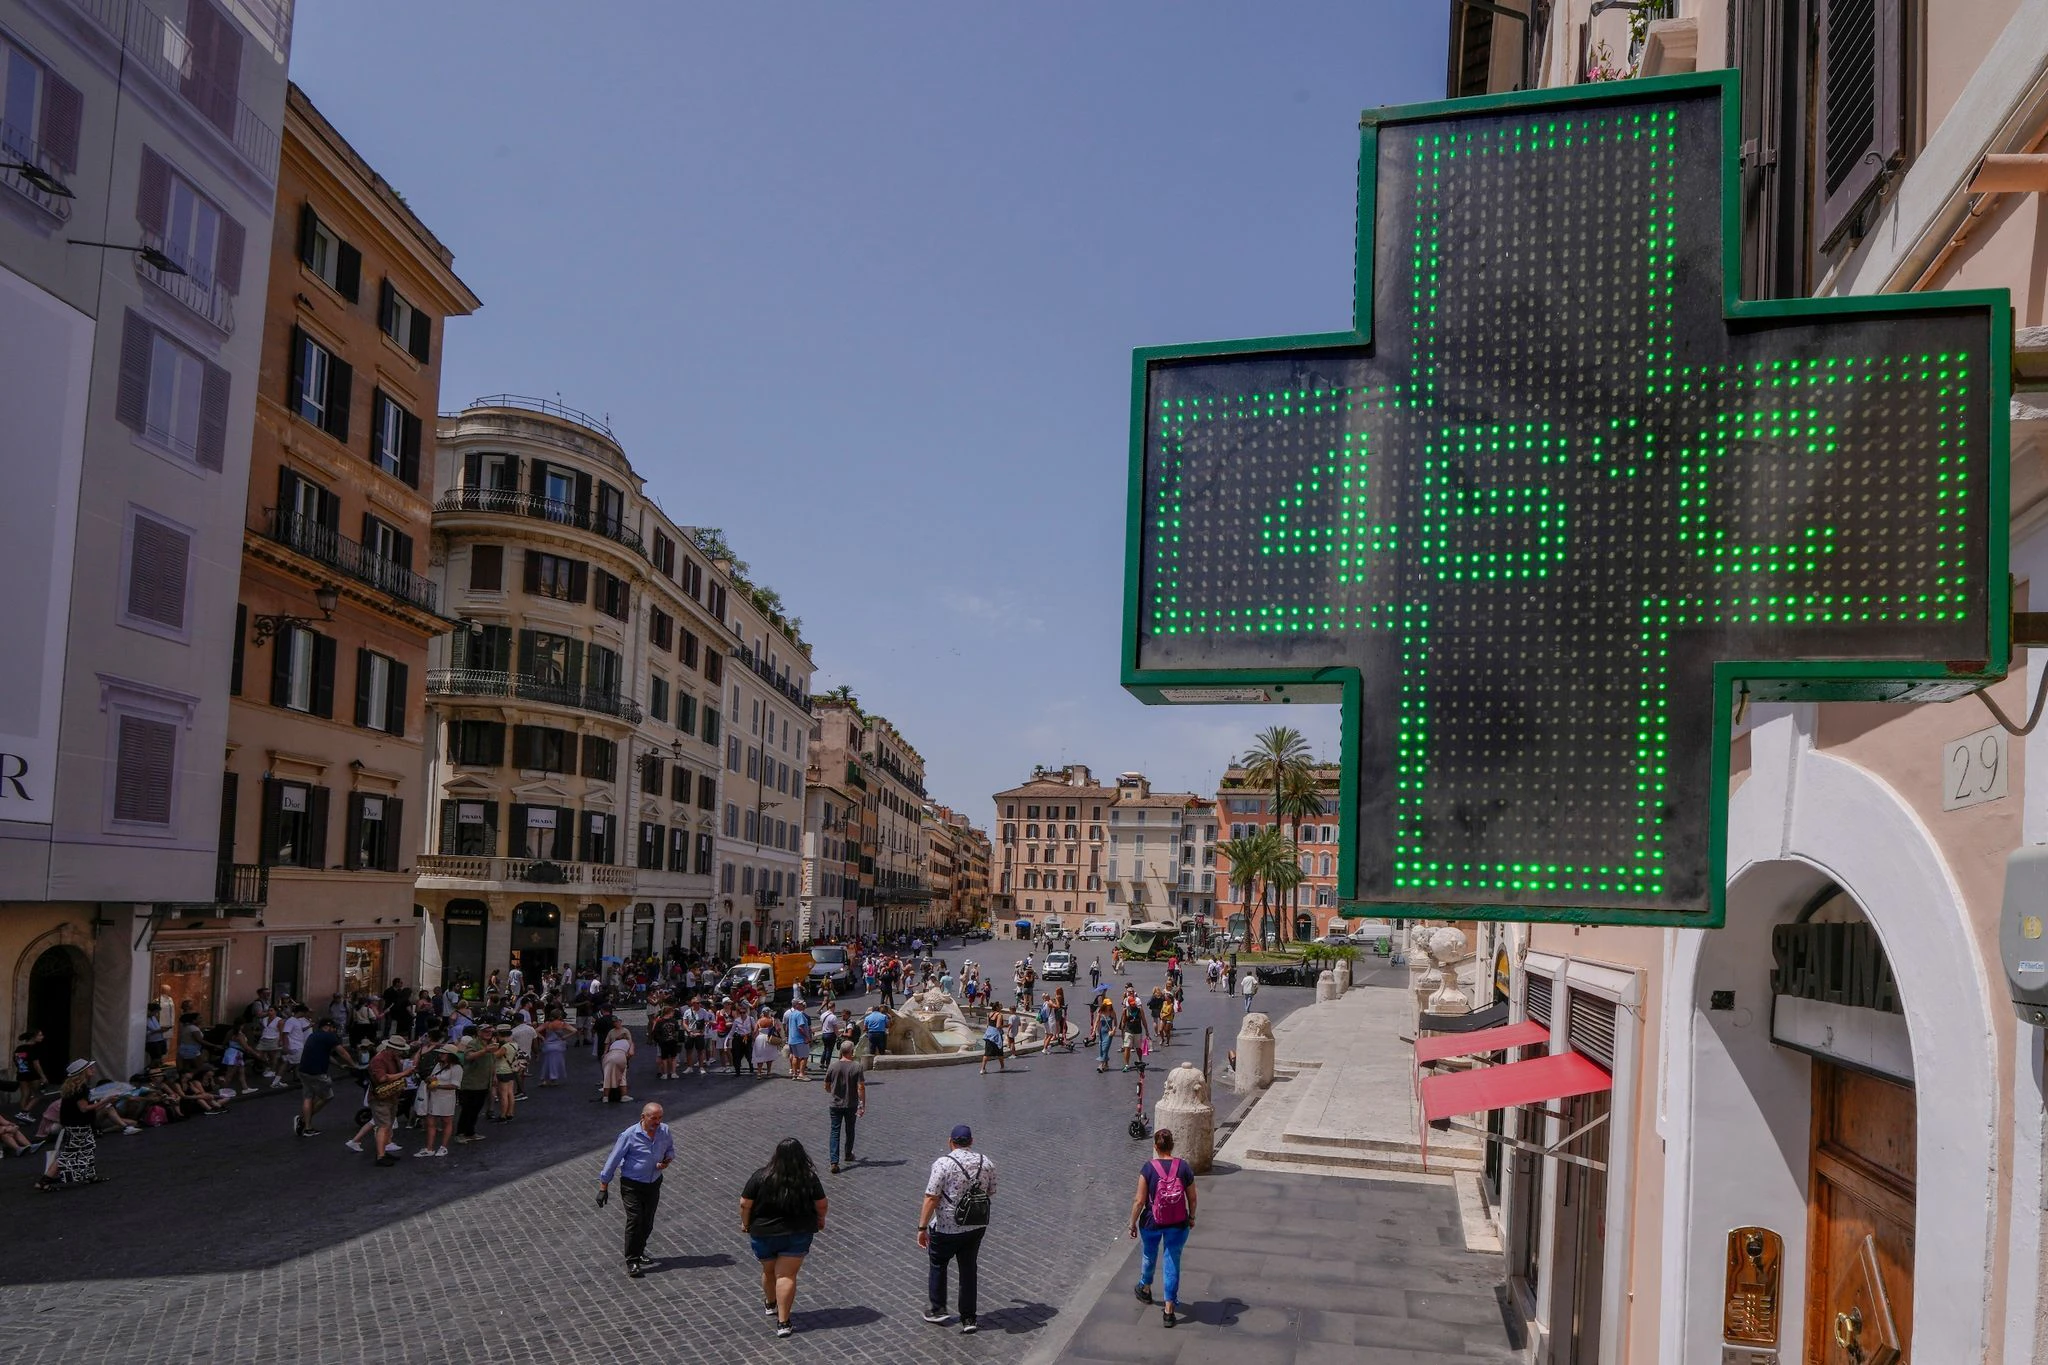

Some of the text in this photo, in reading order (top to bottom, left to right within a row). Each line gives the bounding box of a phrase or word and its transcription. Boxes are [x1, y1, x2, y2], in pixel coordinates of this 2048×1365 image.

[0, 752, 35, 802] R
[1953, 735, 1999, 800] 29
[284, 797, 300, 809] Dior
[1092, 925, 1112, 934] FedEx
